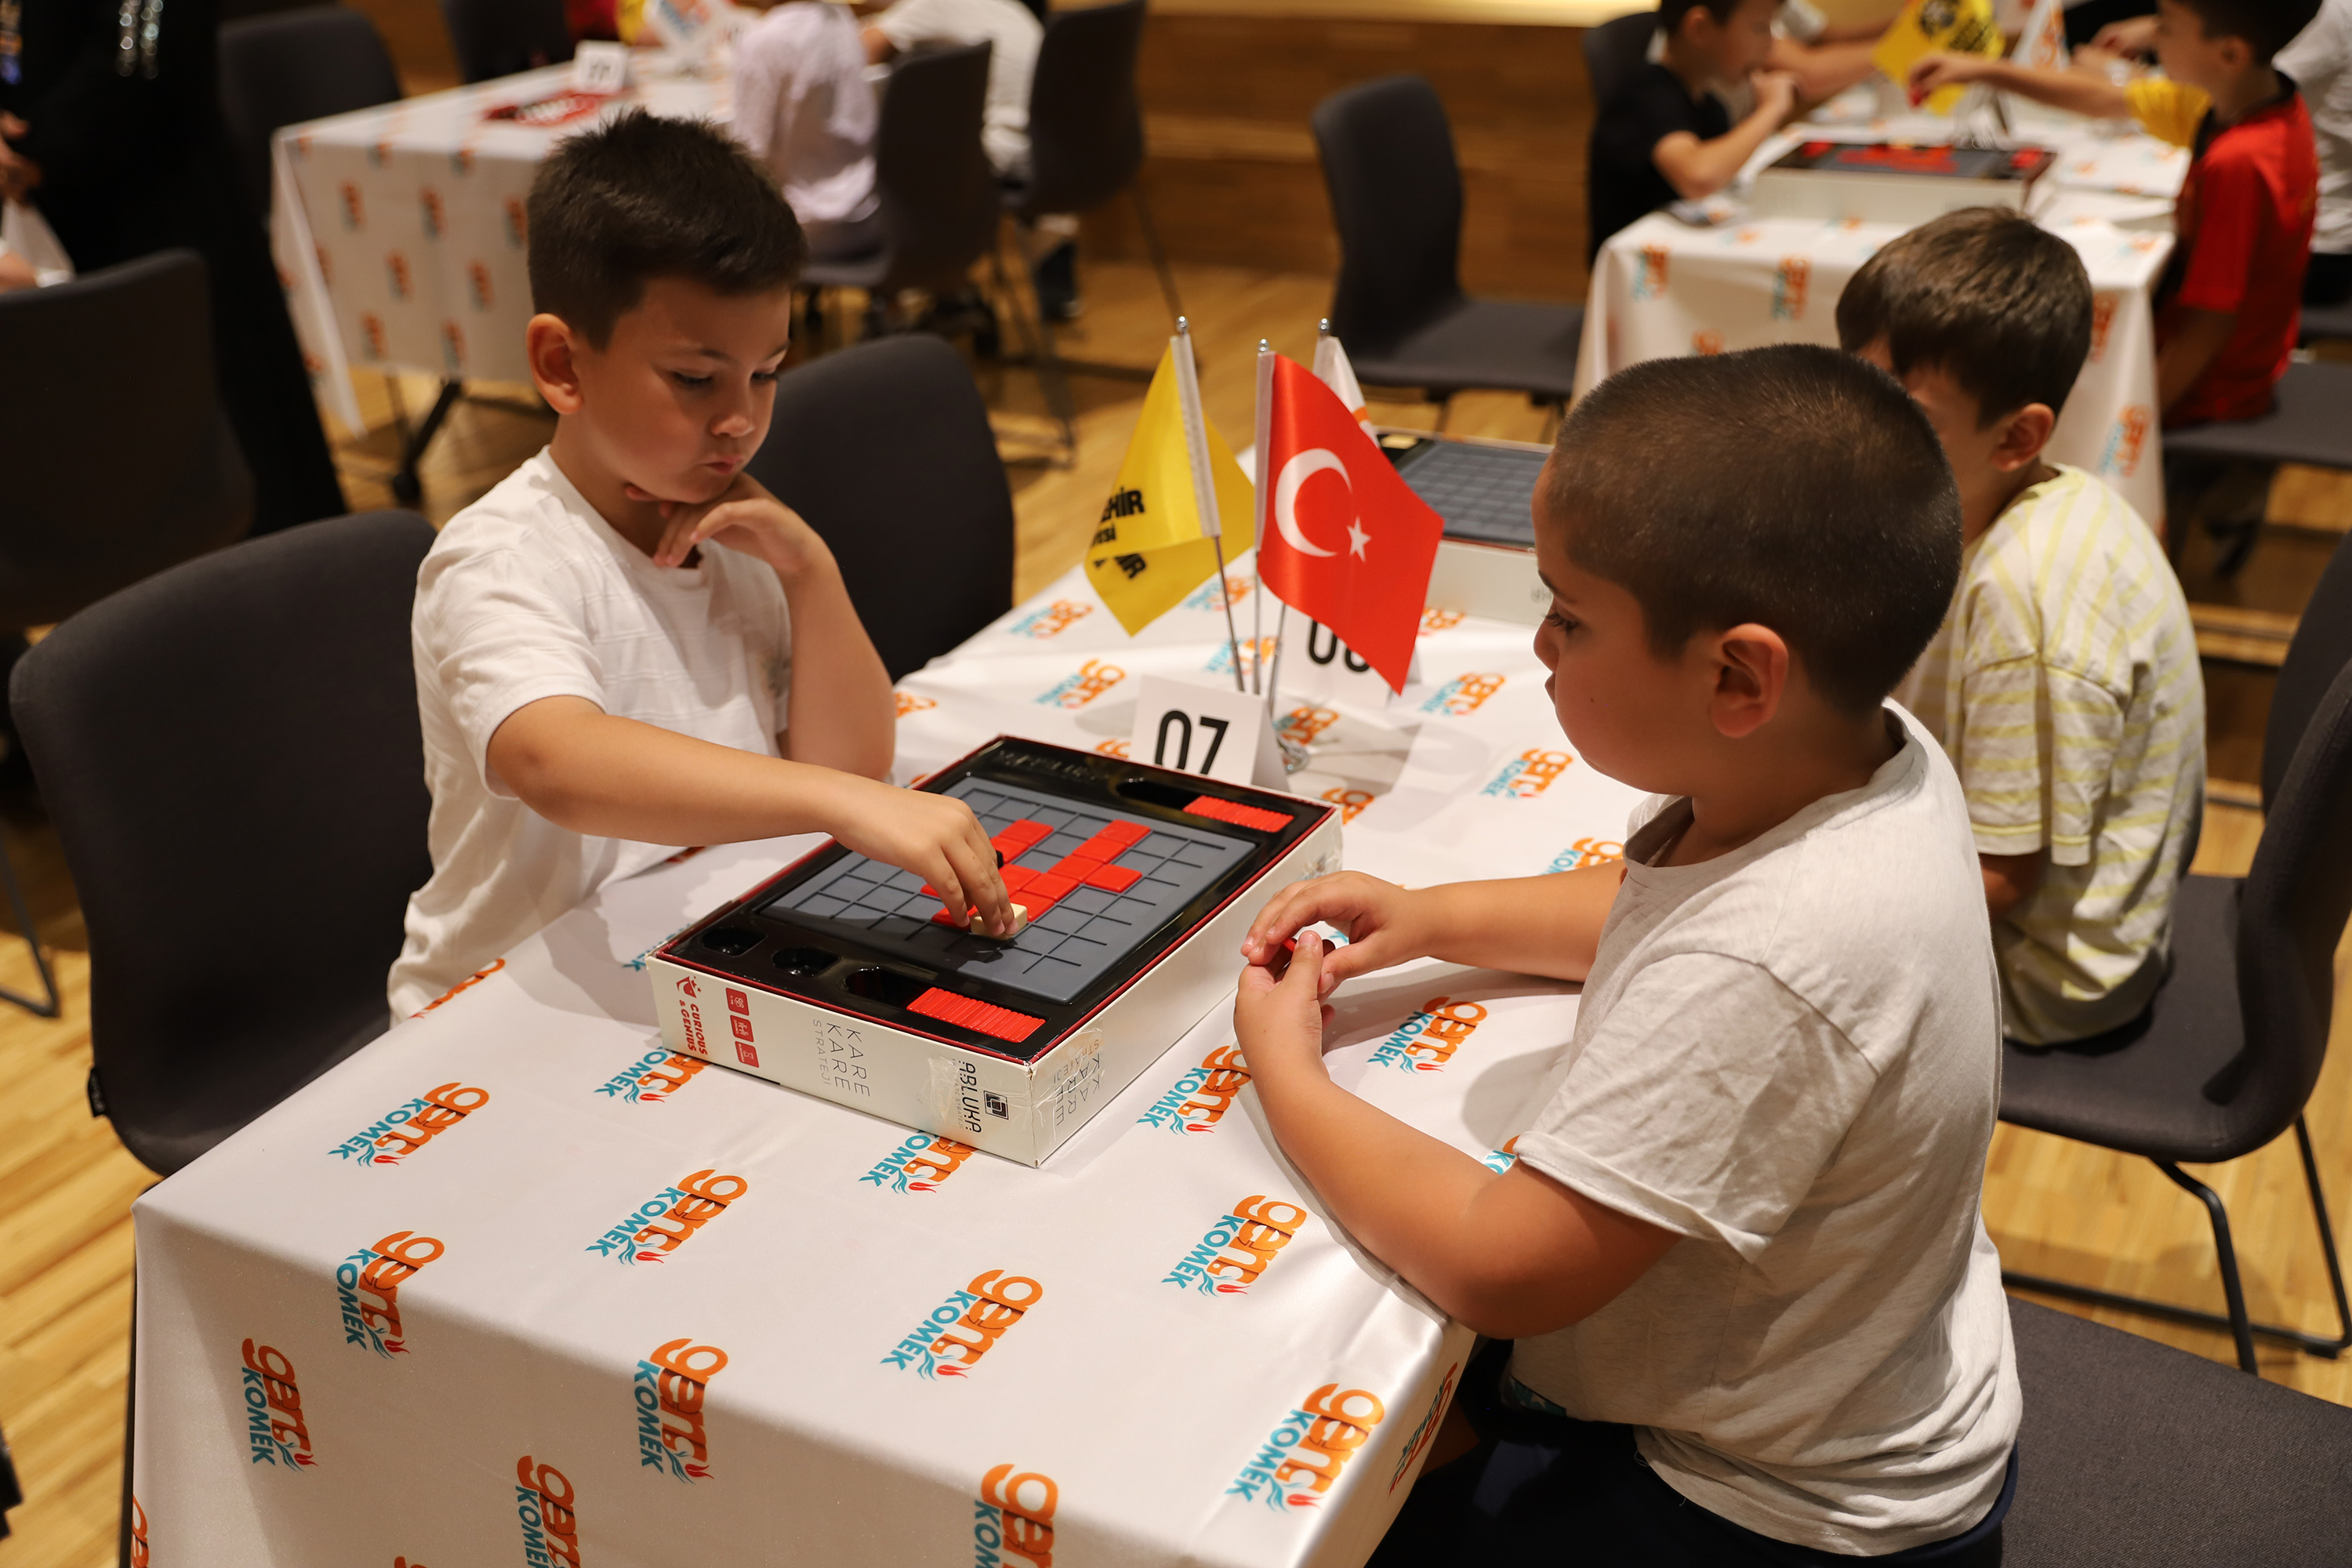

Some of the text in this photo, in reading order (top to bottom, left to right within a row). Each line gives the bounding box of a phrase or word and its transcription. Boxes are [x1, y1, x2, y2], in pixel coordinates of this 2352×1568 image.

[1153, 710, 1229, 775] 07
[681, 1008, 697, 1052] GENIUS
[691, 1003, 708, 1055] CURIOUS
[826, 1022, 851, 1091] KARE
[846, 1028, 871, 1098] KARE
[1367, 1011, 1436, 1068] KOMEK
[593, 1047, 677, 1098] OMEK
[958, 1059, 982, 1134] ABLUKA
[1054, 1053, 1100, 1105] KARE
[1055, 1074, 1100, 1127] KARE
[1136, 1067, 1213, 1129] KOMEK
[327, 1098, 432, 1160] KOMEK
[858, 1130, 938, 1187] OMEK
[585, 1186, 688, 1258] KOMEK
[1161, 1214, 1246, 1290] KOMEK
[336, 1247, 380, 1352] KOMEK
[880, 1290, 978, 1370] KOMEK
[241, 1367, 277, 1466] KOMEK
[633, 1359, 665, 1474] KOMEK
[1225, 1408, 1316, 1503] KOMEK
[974, 1499, 1001, 1568] KOM
[981, 1463, 1058, 1568] gen
